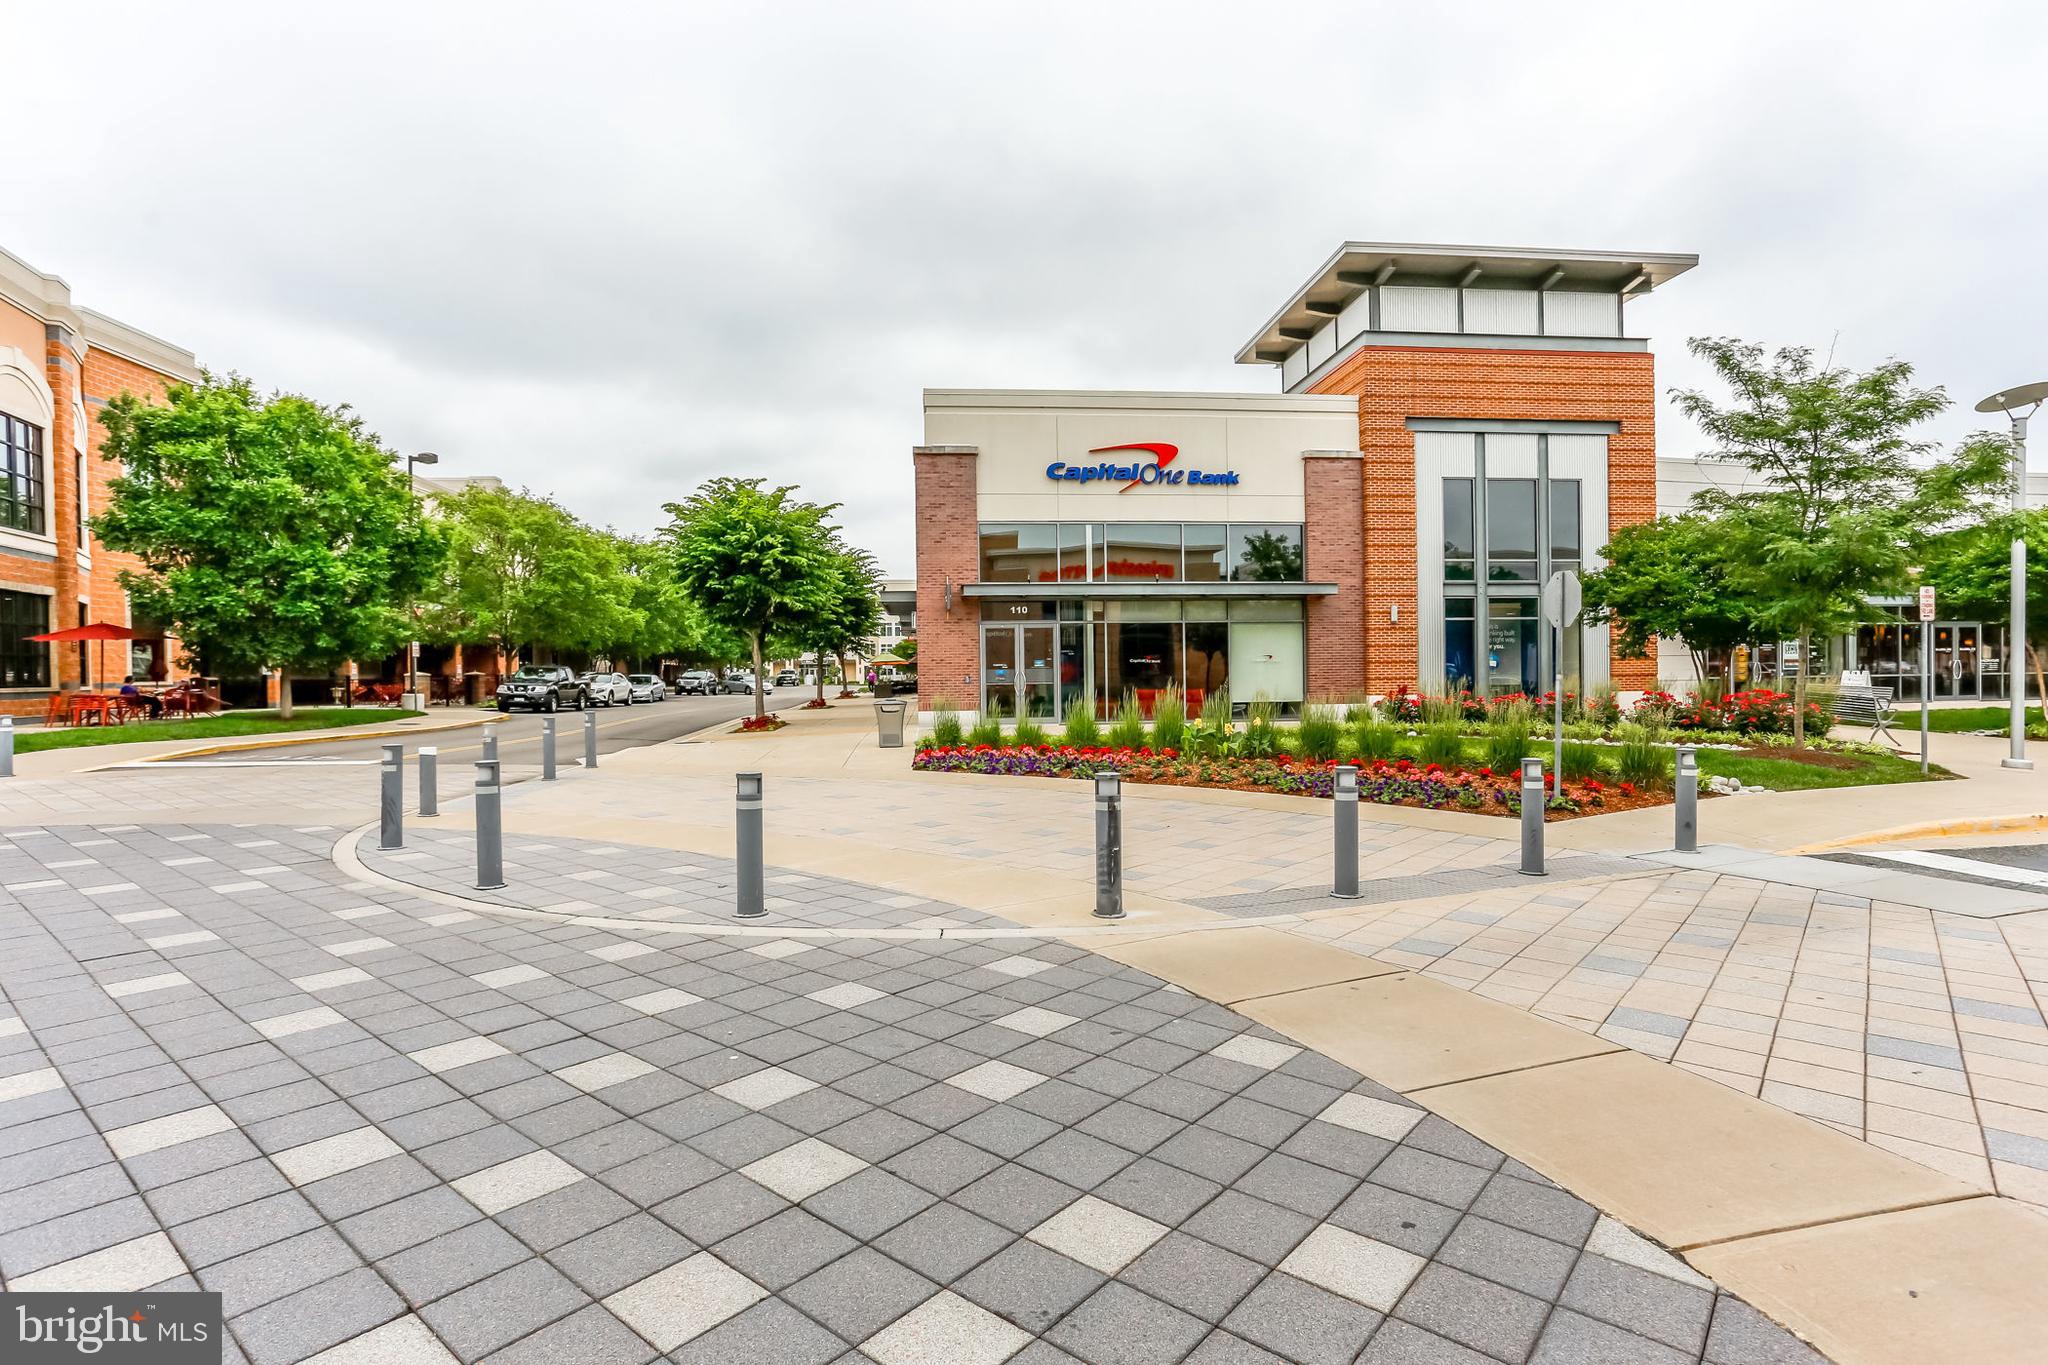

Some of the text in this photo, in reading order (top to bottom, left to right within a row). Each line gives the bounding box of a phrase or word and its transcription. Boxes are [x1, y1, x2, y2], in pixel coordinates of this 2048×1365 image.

[1046, 462, 1240, 485] Capital One Bank
[1010, 606, 1028, 614] 110
